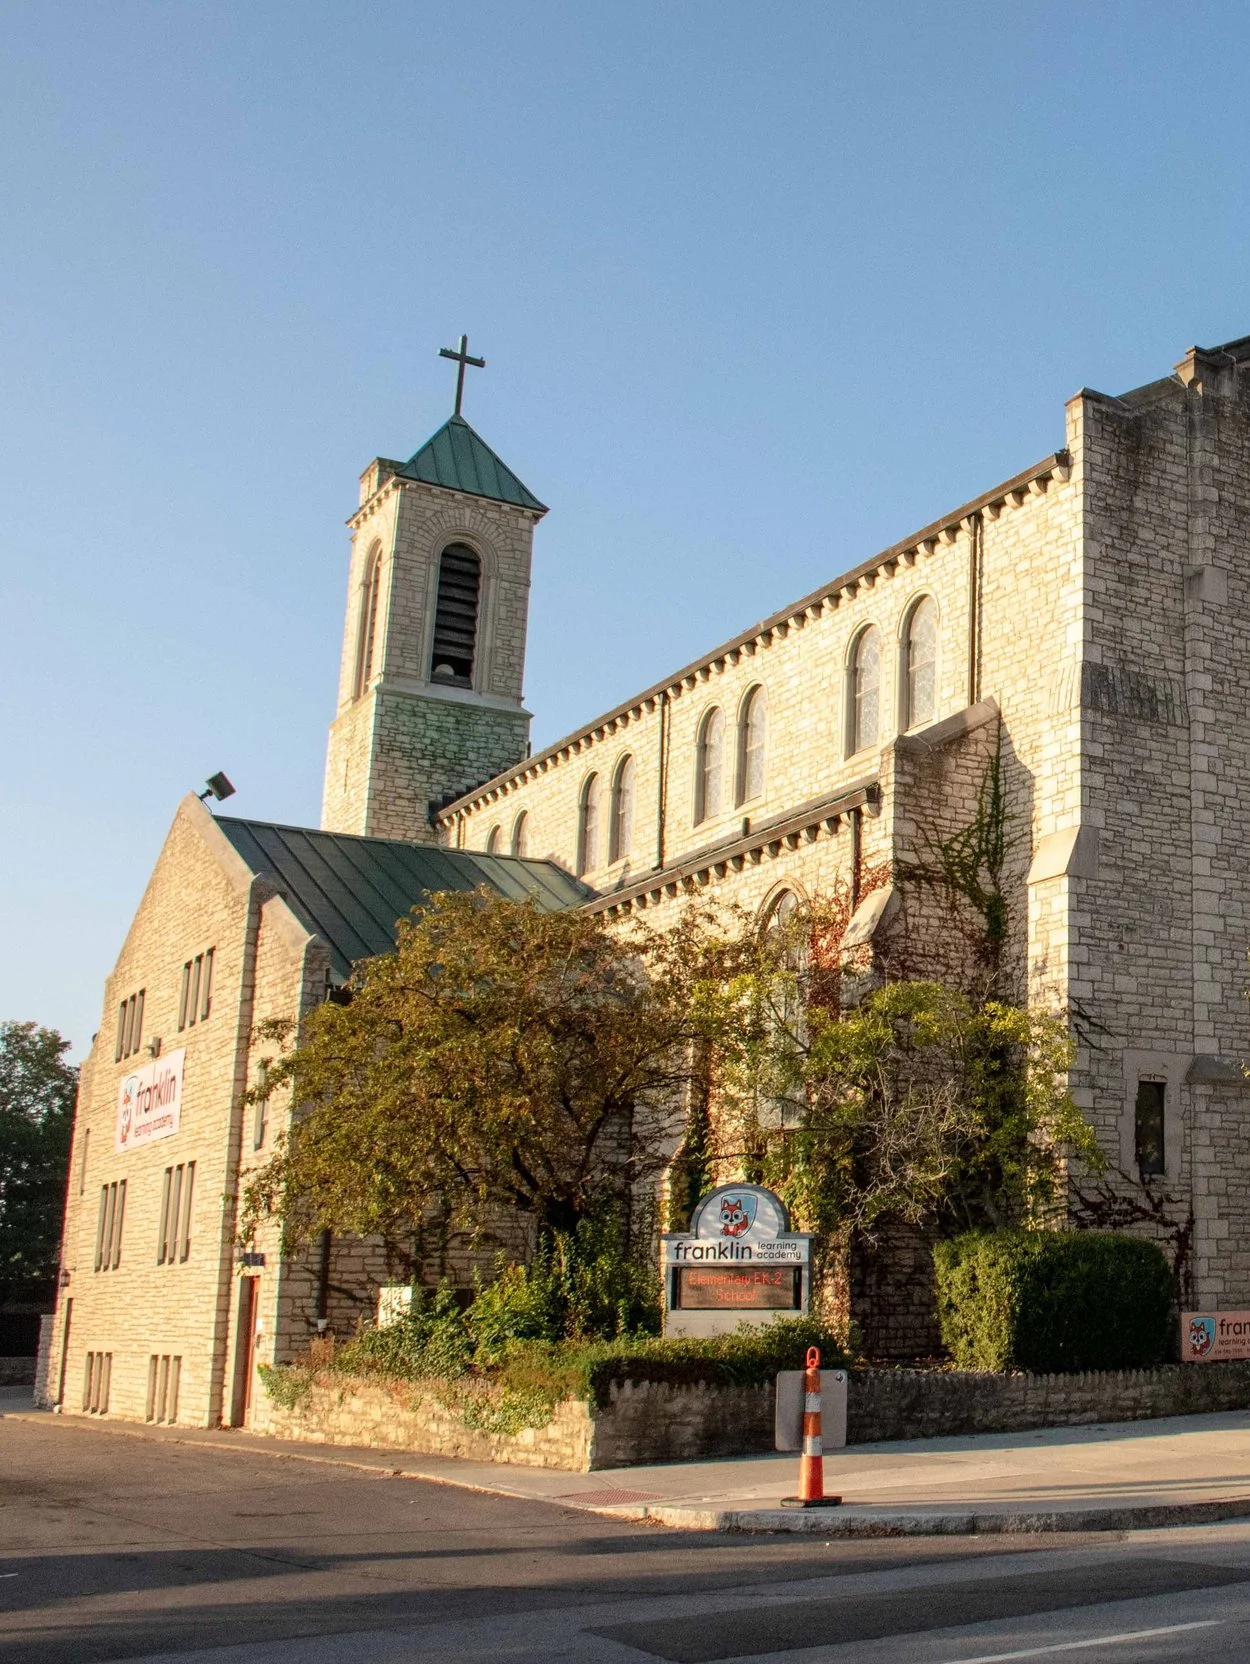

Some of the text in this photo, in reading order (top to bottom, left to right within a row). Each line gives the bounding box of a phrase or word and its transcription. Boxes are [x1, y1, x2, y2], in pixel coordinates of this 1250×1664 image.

[135, 1068, 176, 1116] franklin
[674, 1241, 752, 1260] franklin
[757, 1241, 797, 1252] learning
[756, 1250, 801, 1260] academy
[687, 1271, 782, 1288] Elementary EK-2
[715, 1288, 757, 1302] School
[1218, 1337, 1246, 1346] learning
